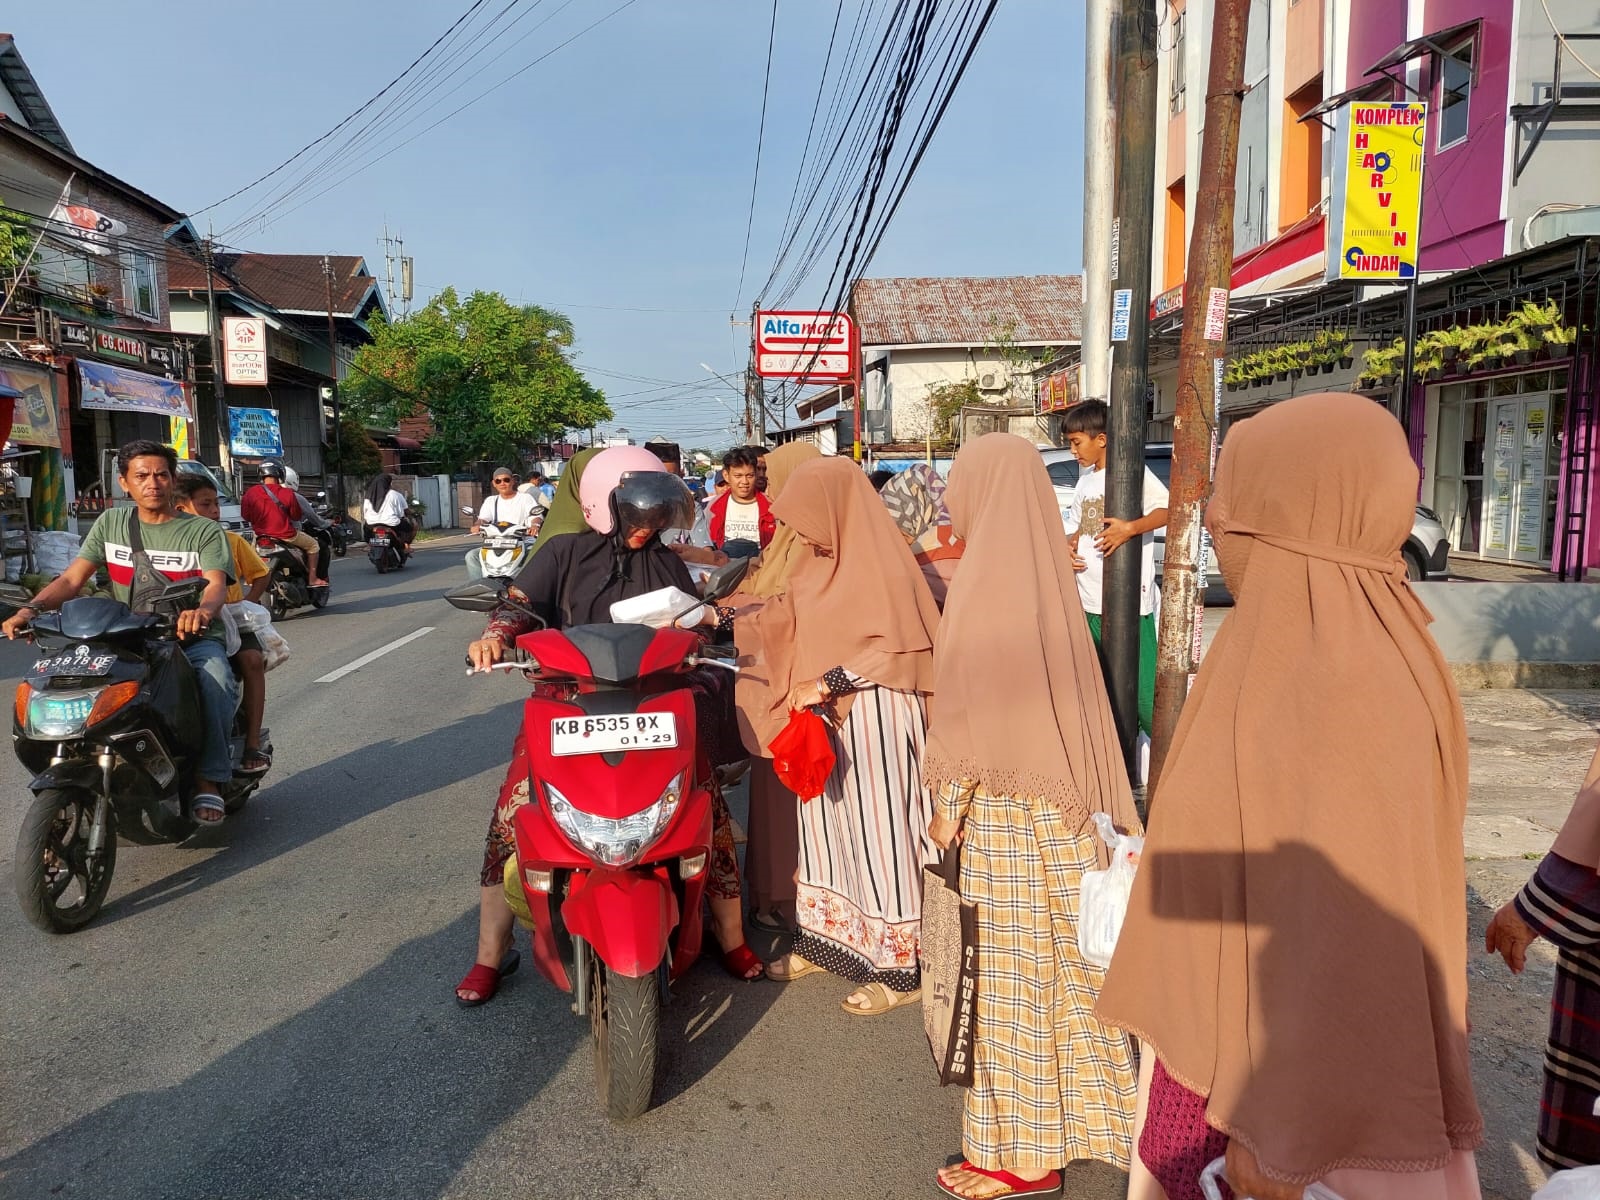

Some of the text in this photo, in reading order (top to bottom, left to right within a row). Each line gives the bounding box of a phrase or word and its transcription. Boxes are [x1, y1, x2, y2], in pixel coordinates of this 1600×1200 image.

[1355, 108, 1420, 125] KOMPLEK
[1355, 133, 1408, 246] HARVIN
[1356, 255, 1400, 271] INDAH
[764, 319, 845, 335] Alfamart
[117, 339, 143, 358] CITRA
[555, 720, 579, 735] KB
[584, 717, 629, 733] 6535
